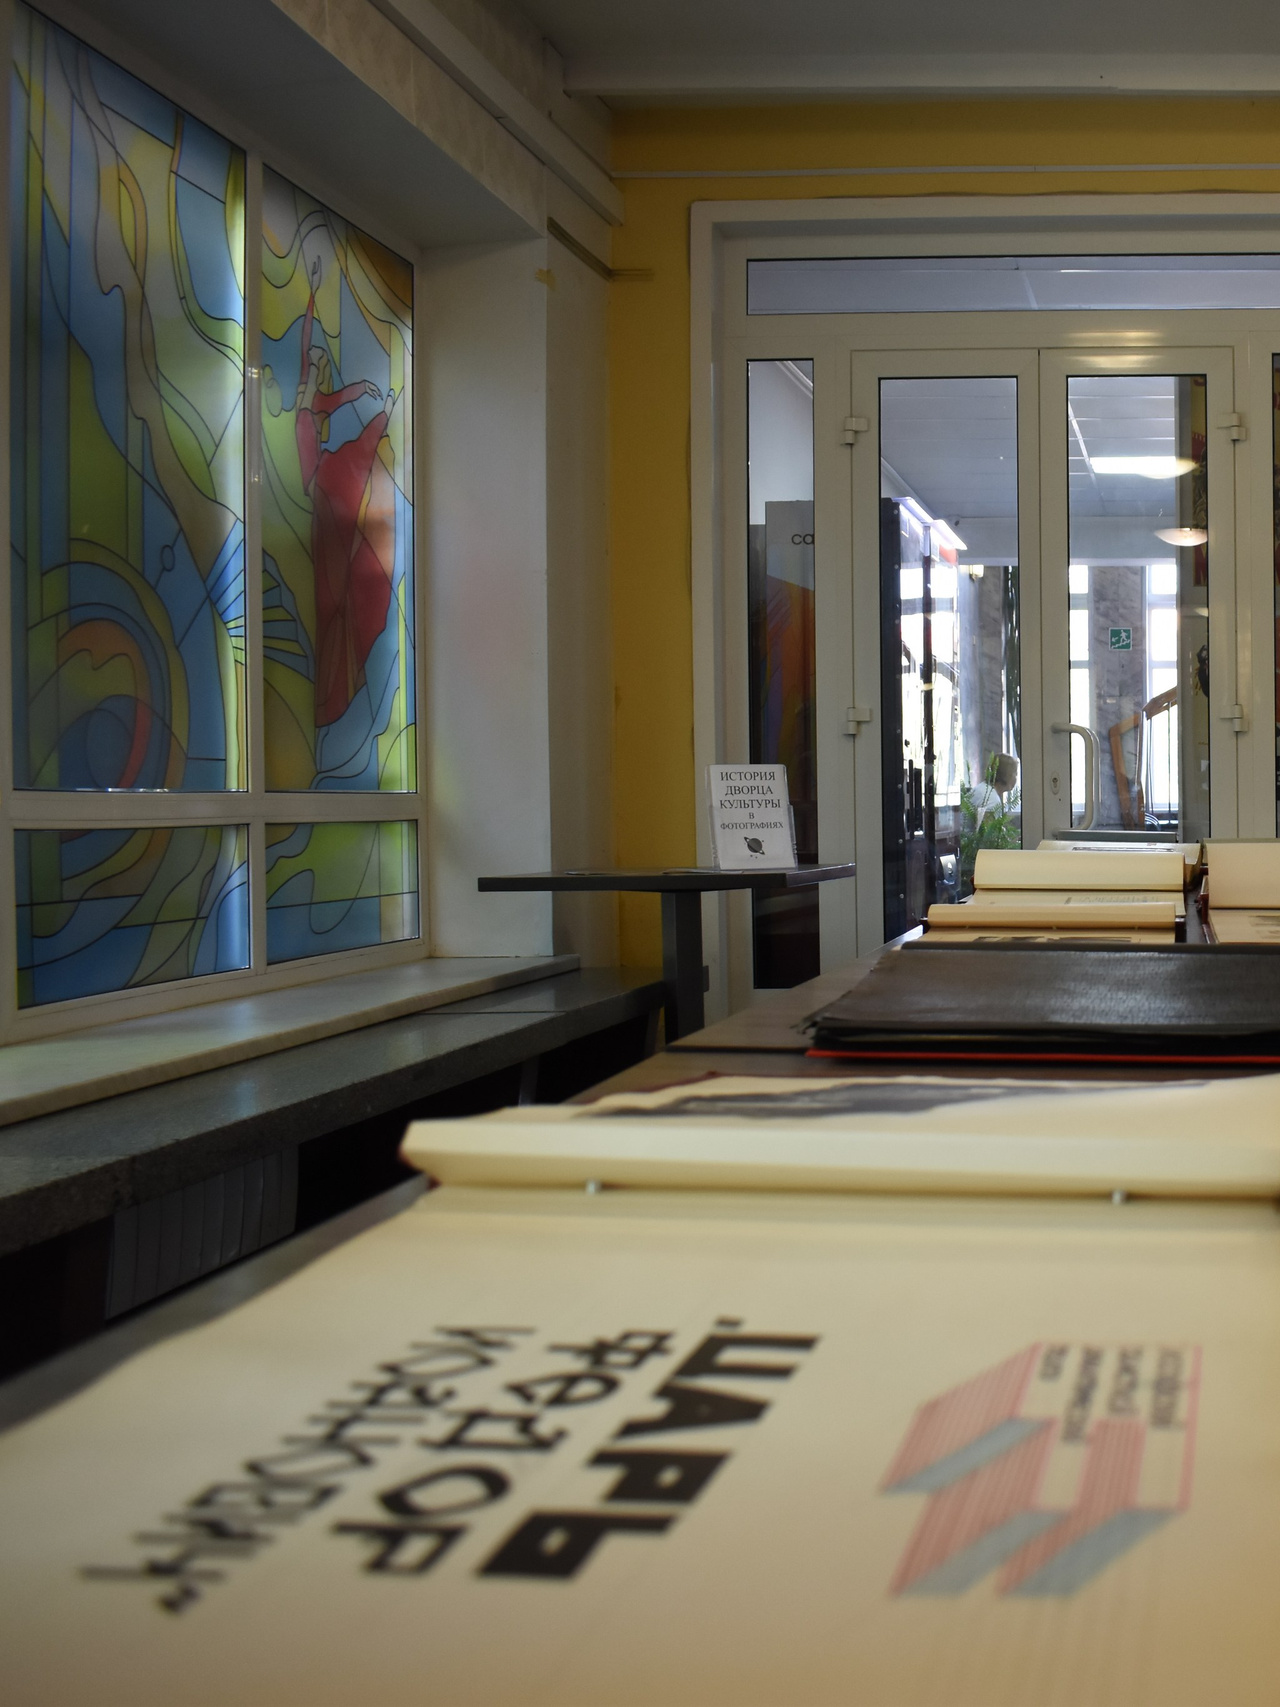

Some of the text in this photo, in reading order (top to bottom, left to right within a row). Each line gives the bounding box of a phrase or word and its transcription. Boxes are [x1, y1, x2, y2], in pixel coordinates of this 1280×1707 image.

[720, 771, 776, 782] ИСТОРИЯ
[725, 785, 774, 796] ДВОРЦА
[719, 799, 781, 810] КУЛЬТУРЫ
[720, 821, 784, 830] ФОТОГРАФИЯХ
